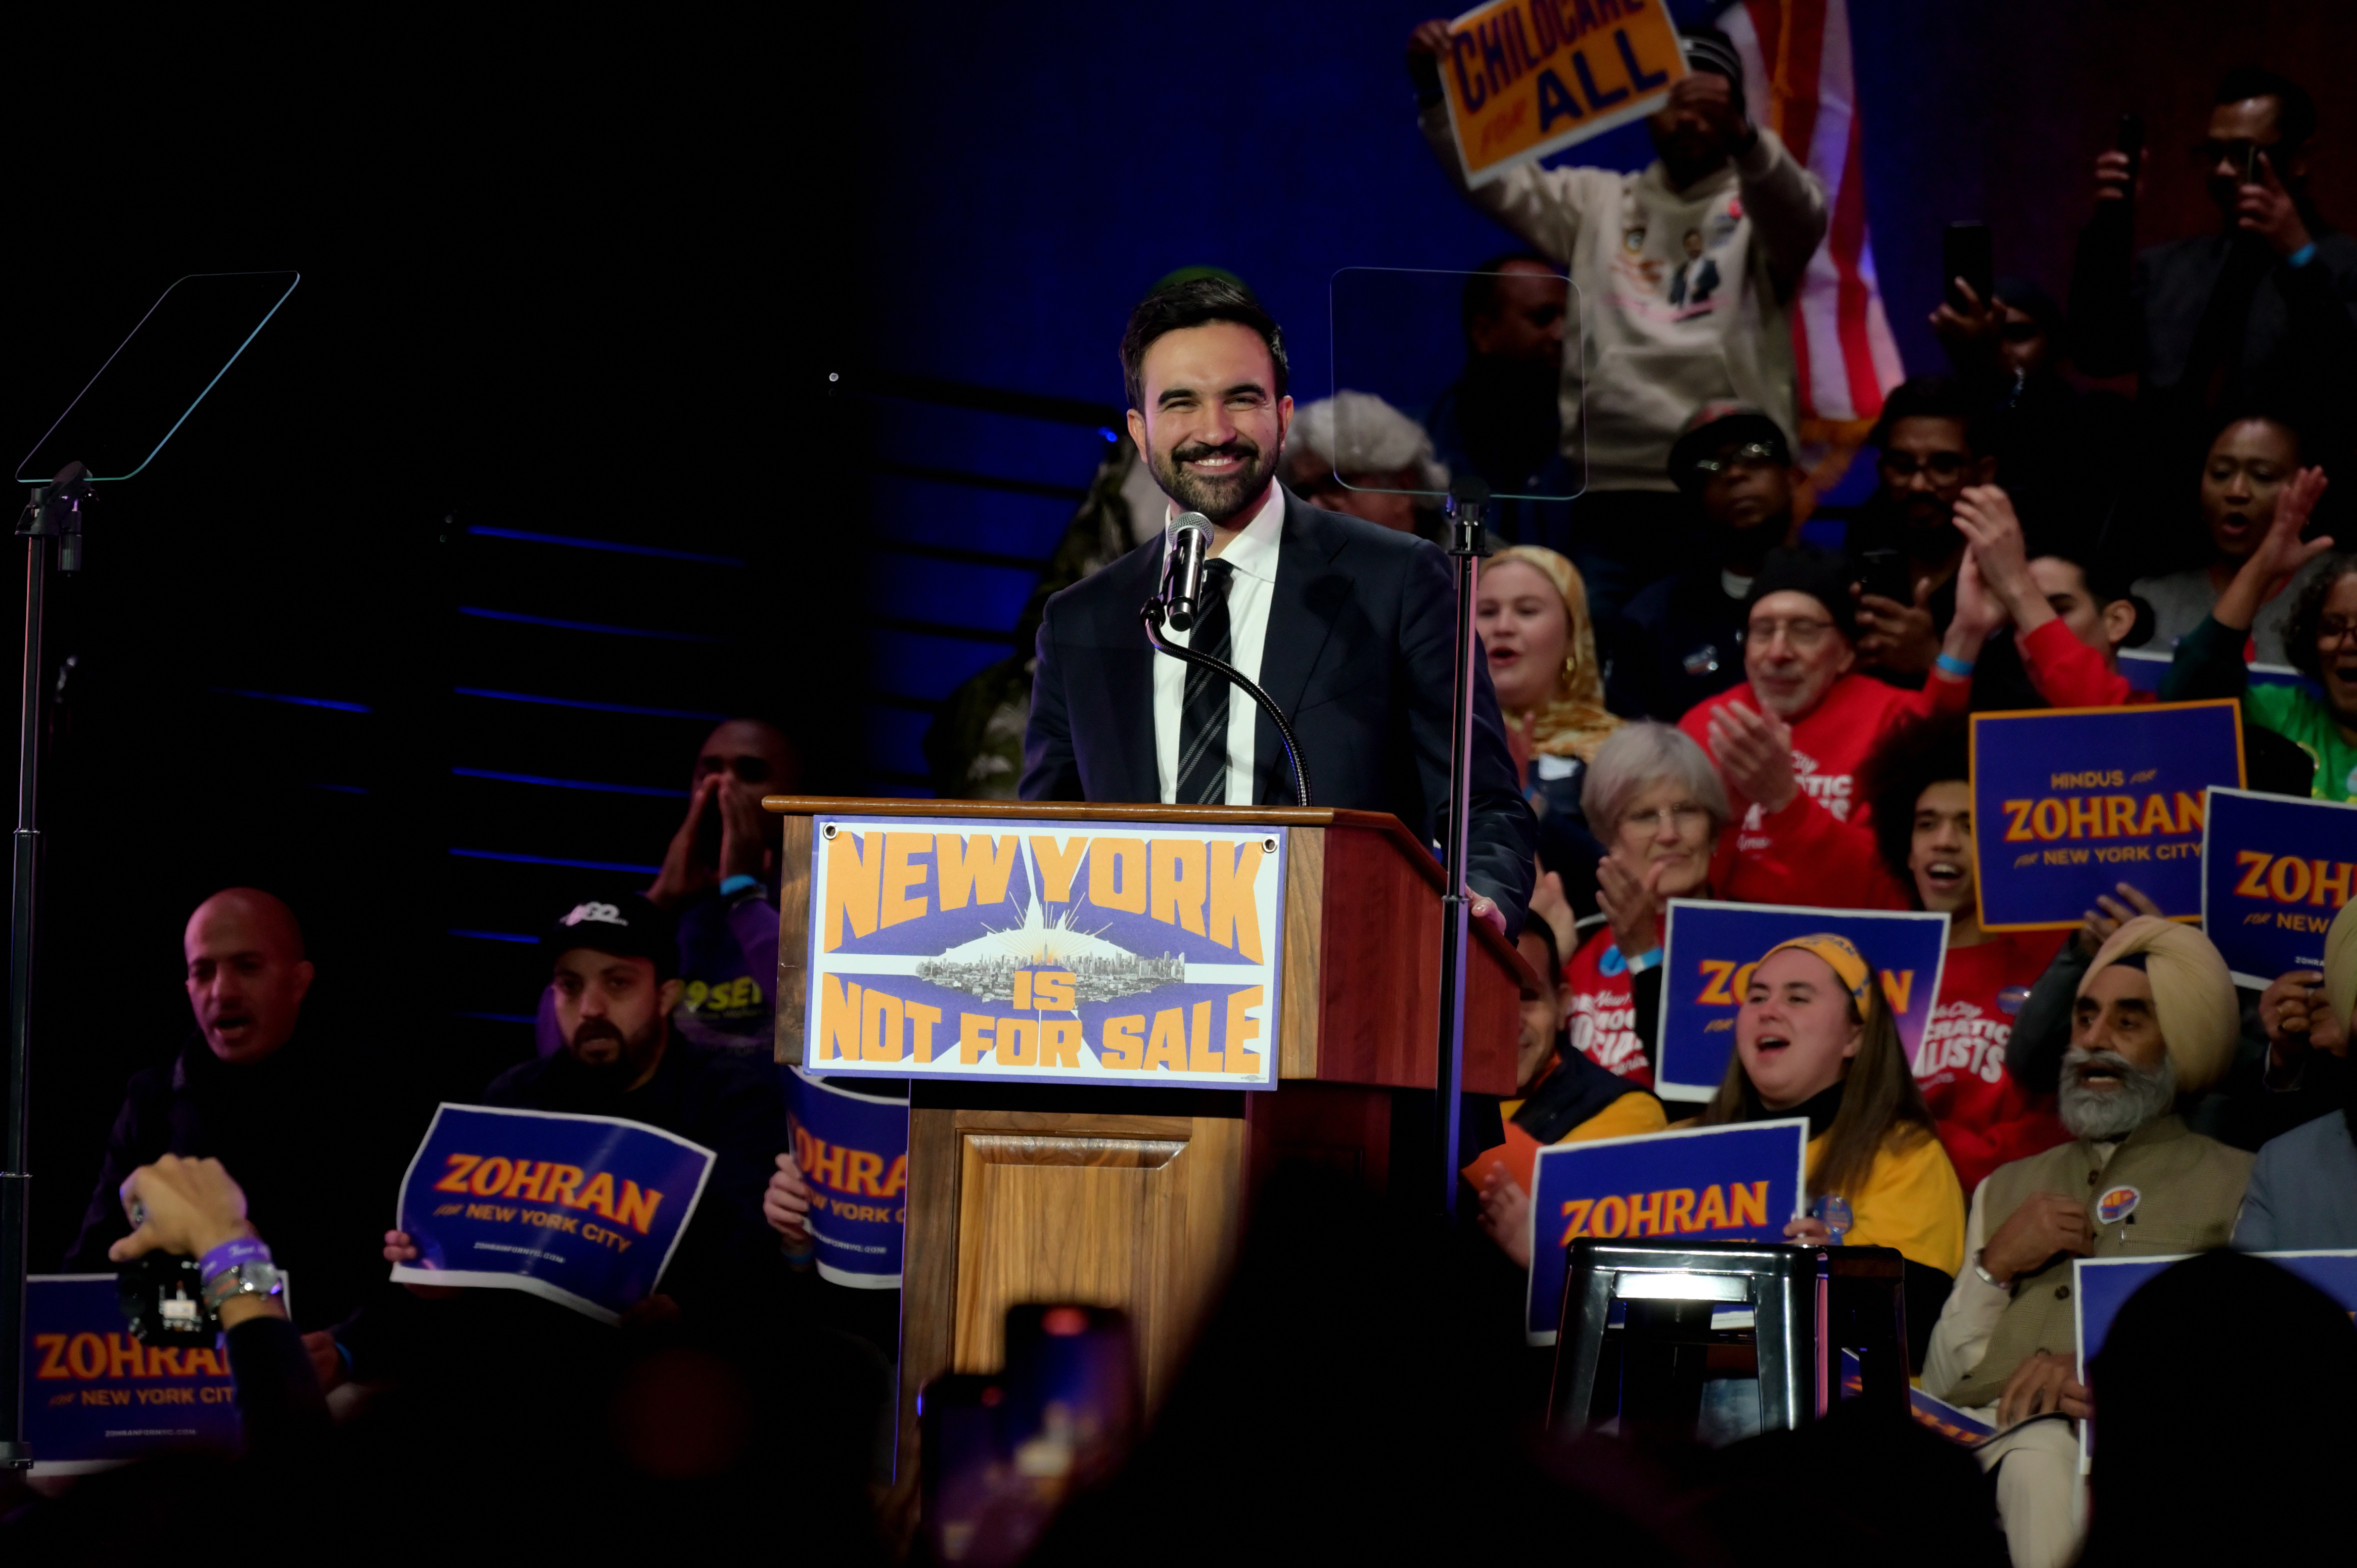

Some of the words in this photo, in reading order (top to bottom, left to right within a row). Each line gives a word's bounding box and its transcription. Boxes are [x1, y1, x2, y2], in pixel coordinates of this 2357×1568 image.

[1538, 29, 1667, 133] ALL
[2051, 770, 2124, 790] HINDUS
[2130, 768, 2157, 785] FOR
[2003, 790, 2206, 842] ZOHRAN
[2014, 852, 2038, 869] FOR
[2043, 848, 2089, 865] NEW
[2094, 846, 2152, 863] YORK
[2156, 842, 2203, 860] CITY
[2234, 850, 2356, 908] ZOH
[823, 831, 1019, 954] NEW
[1029, 836, 1265, 966] YORK
[2243, 912, 2272, 925] FOR
[2277, 912, 2329, 933] NEW
[1013, 971, 1076, 1011] IS
[819, 972, 942, 1064] NOT
[960, 1012, 1083, 1068] FOR
[1101, 984, 1265, 1075] SALE
[1704, 1018, 1734, 1033] FOR
[795, 1126, 908, 1197] OHRA
[433, 1153, 665, 1235] ZOHRAN
[830, 1199, 891, 1223] YORK
[1559, 1180, 1769, 1247] ZOHRAN
[465, 1203, 518, 1222] NEW
[521, 1210, 580, 1234] YORK
[581, 1222, 633, 1254] CITY
[35, 1332, 232, 1379] ZOHRA
[81, 1389, 131, 1406] NEW
[135, 1387, 195, 1406] YORK
[199, 1387, 233, 1404] CIT
[105, 1429, 197, 1438] ZOHRANFORNYC.COM
